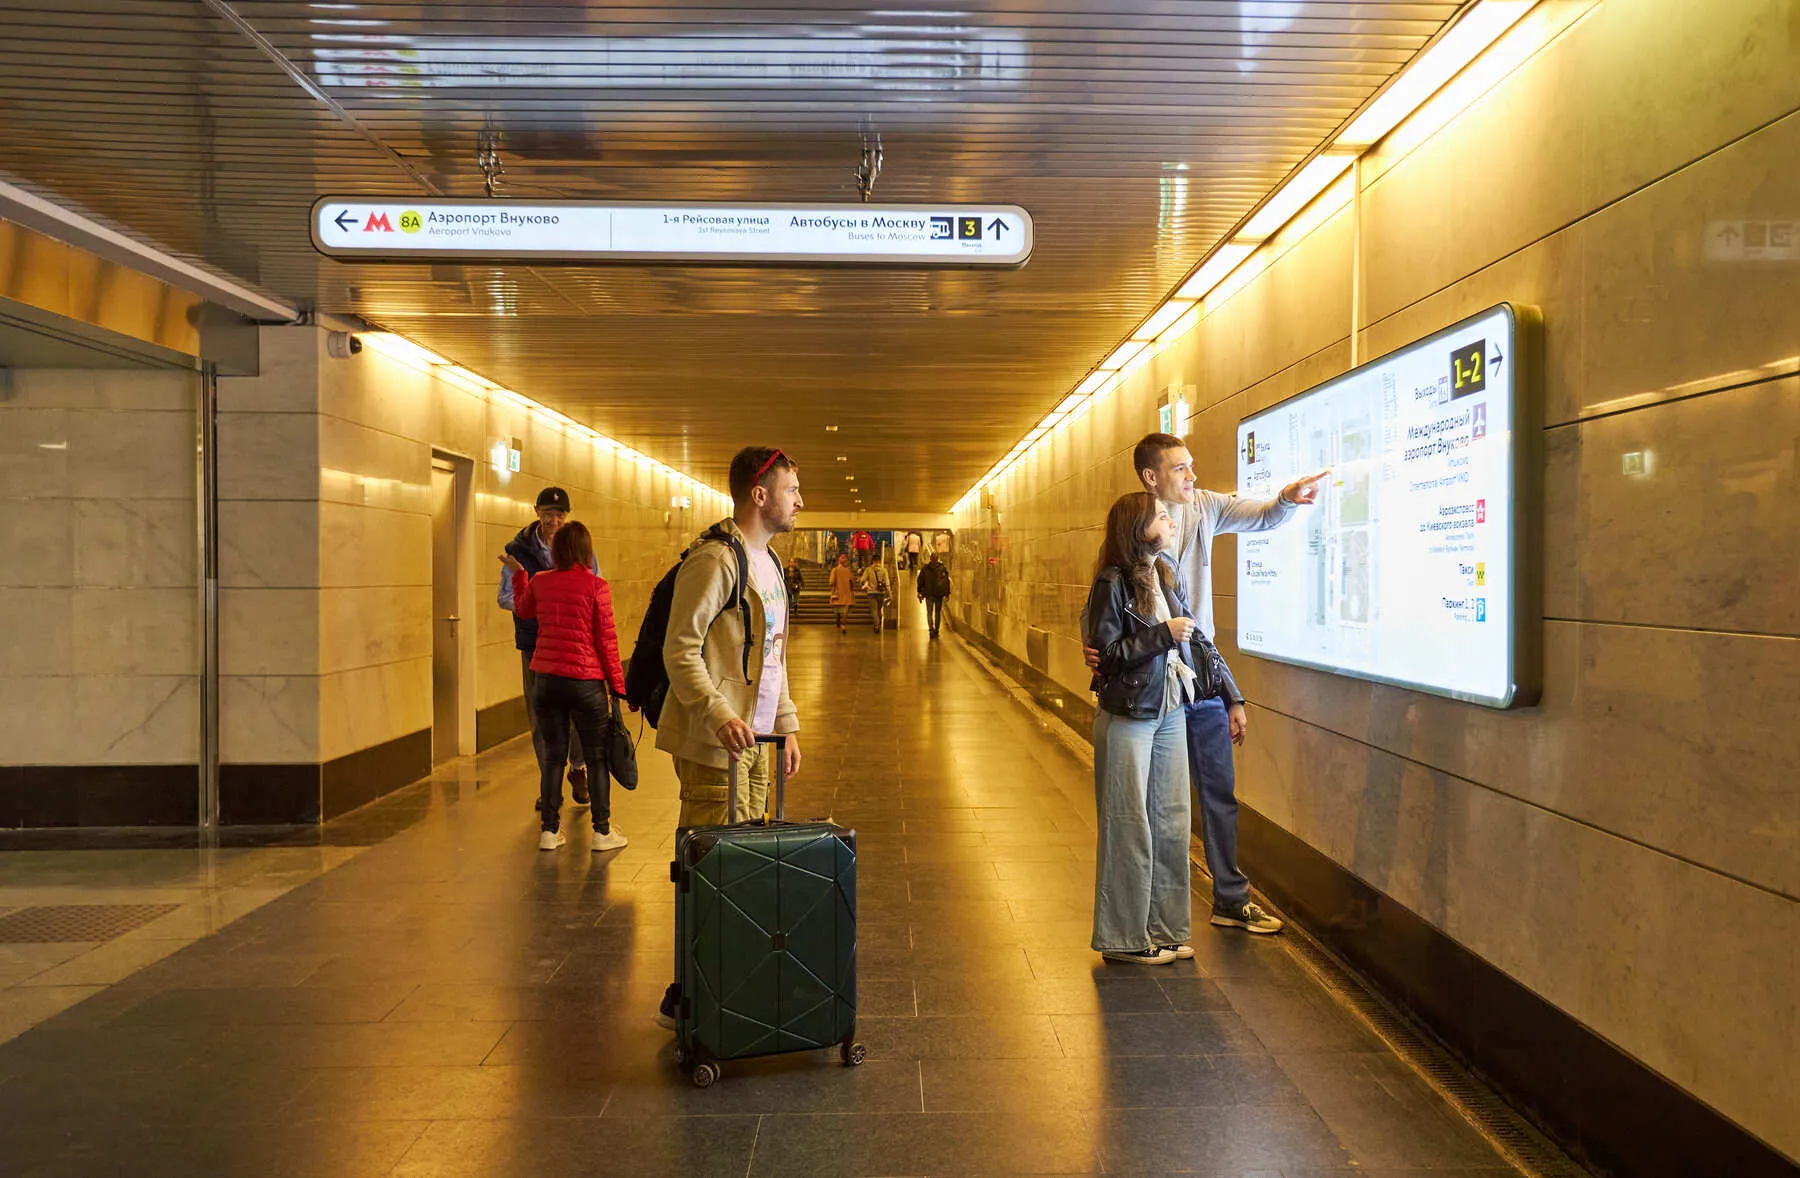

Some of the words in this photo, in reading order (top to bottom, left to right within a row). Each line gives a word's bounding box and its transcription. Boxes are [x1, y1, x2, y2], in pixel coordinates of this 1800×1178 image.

[428, 211, 496, 225] Аэропорт
[500, 212, 560, 227] Внуково
[663, 214, 680, 224] 1-я
[682, 214, 735, 225] Рейсовая
[737, 216, 770, 227] улица
[790, 216, 857, 231] Автобусы
[861, 219, 869, 228] в
[872, 217, 926, 231] Москву
[428, 227, 470, 238] Aeroport
[472, 227, 512, 237] Vnukovo
[964, 220, 976, 236] 3
[848, 231, 874, 241] Buses
[877, 231, 886, 241] to
[888, 232, 926, 242] Moscow
[1454, 351, 1482, 389] 1-2
[1408, 408, 1470, 440] Международный
[1248, 438, 1254, 458] 3
[1404, 443, 1437, 461] аэропорт
[1437, 435, 1470, 456] Внуково
